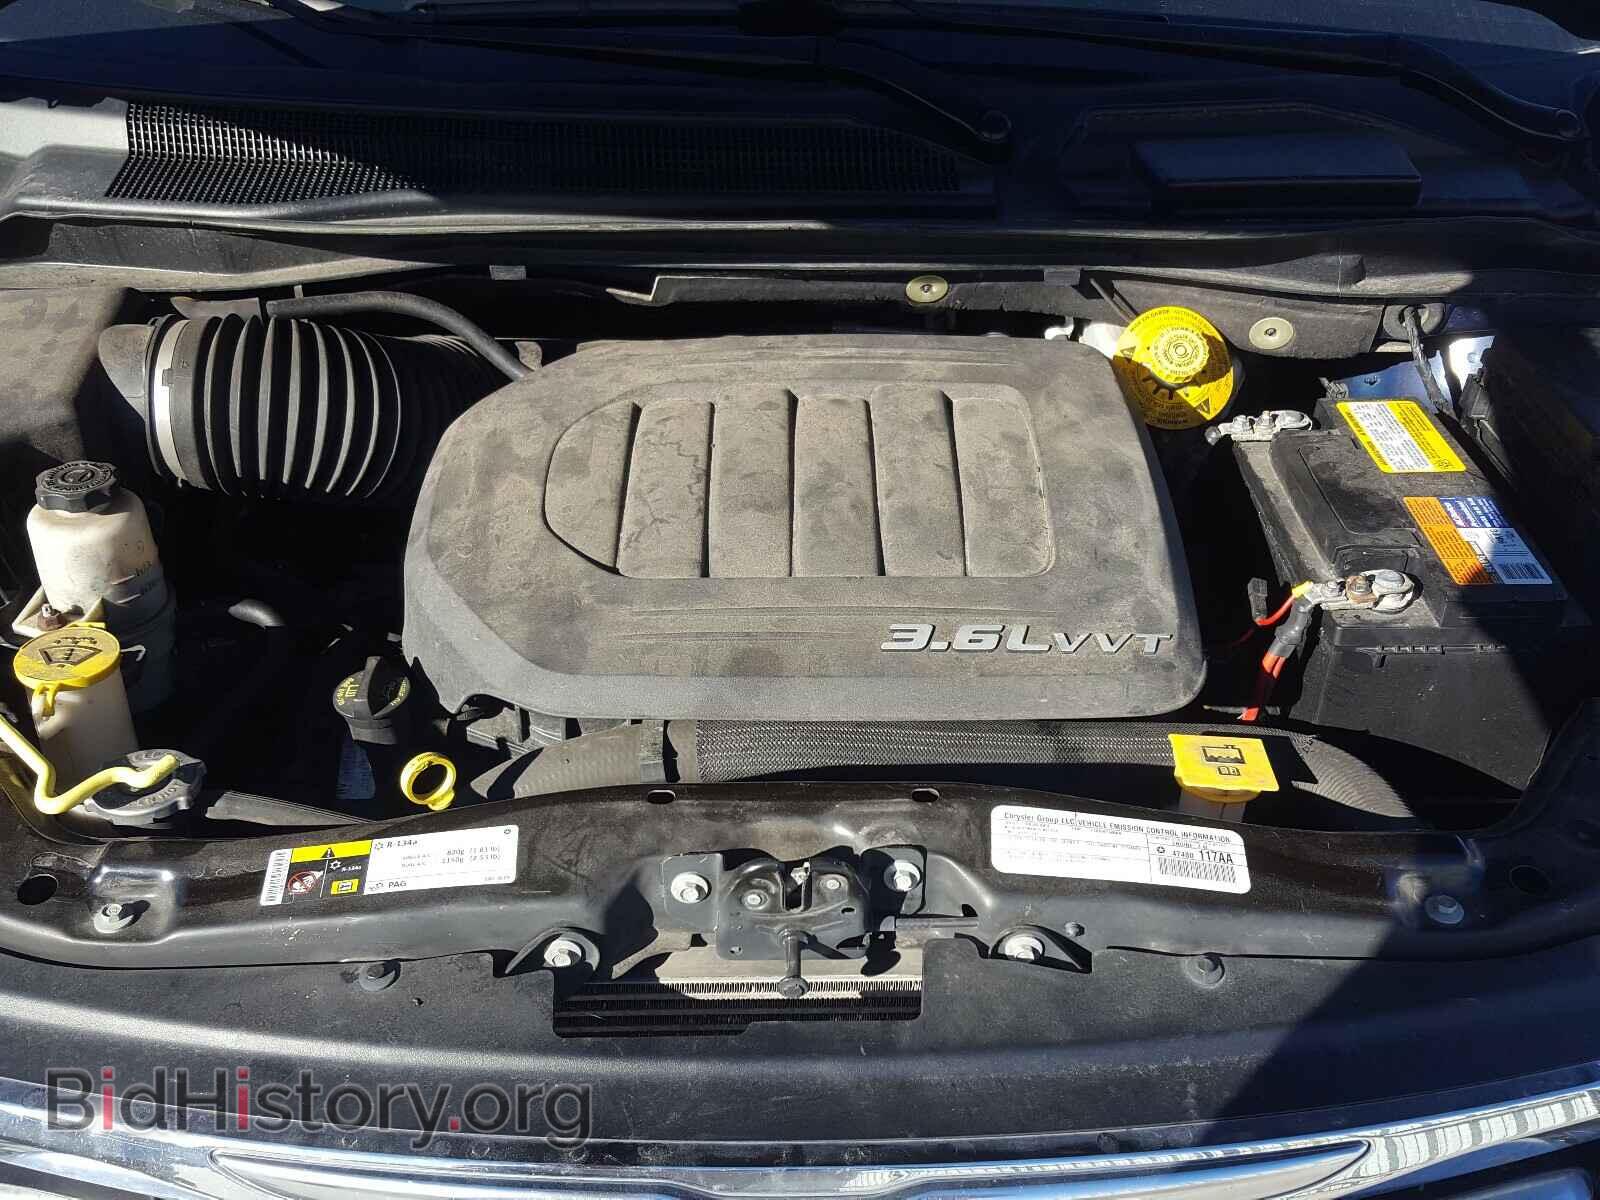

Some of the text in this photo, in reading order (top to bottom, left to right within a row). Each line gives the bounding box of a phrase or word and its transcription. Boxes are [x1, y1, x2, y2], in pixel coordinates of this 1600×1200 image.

[1004, 812, 1034, 821] Chrysler
[1037, 814, 1059, 825] Group
[1078, 819, 1107, 829] VEHICLE
[1109, 823, 1144, 833] EMISSION
[1146, 827, 1178, 837] CONTROL
[1181, 831, 1231, 843] INFORMATION
[1199, 849, 1234, 865] 117AA
[388, 880, 407, 888] PAG
